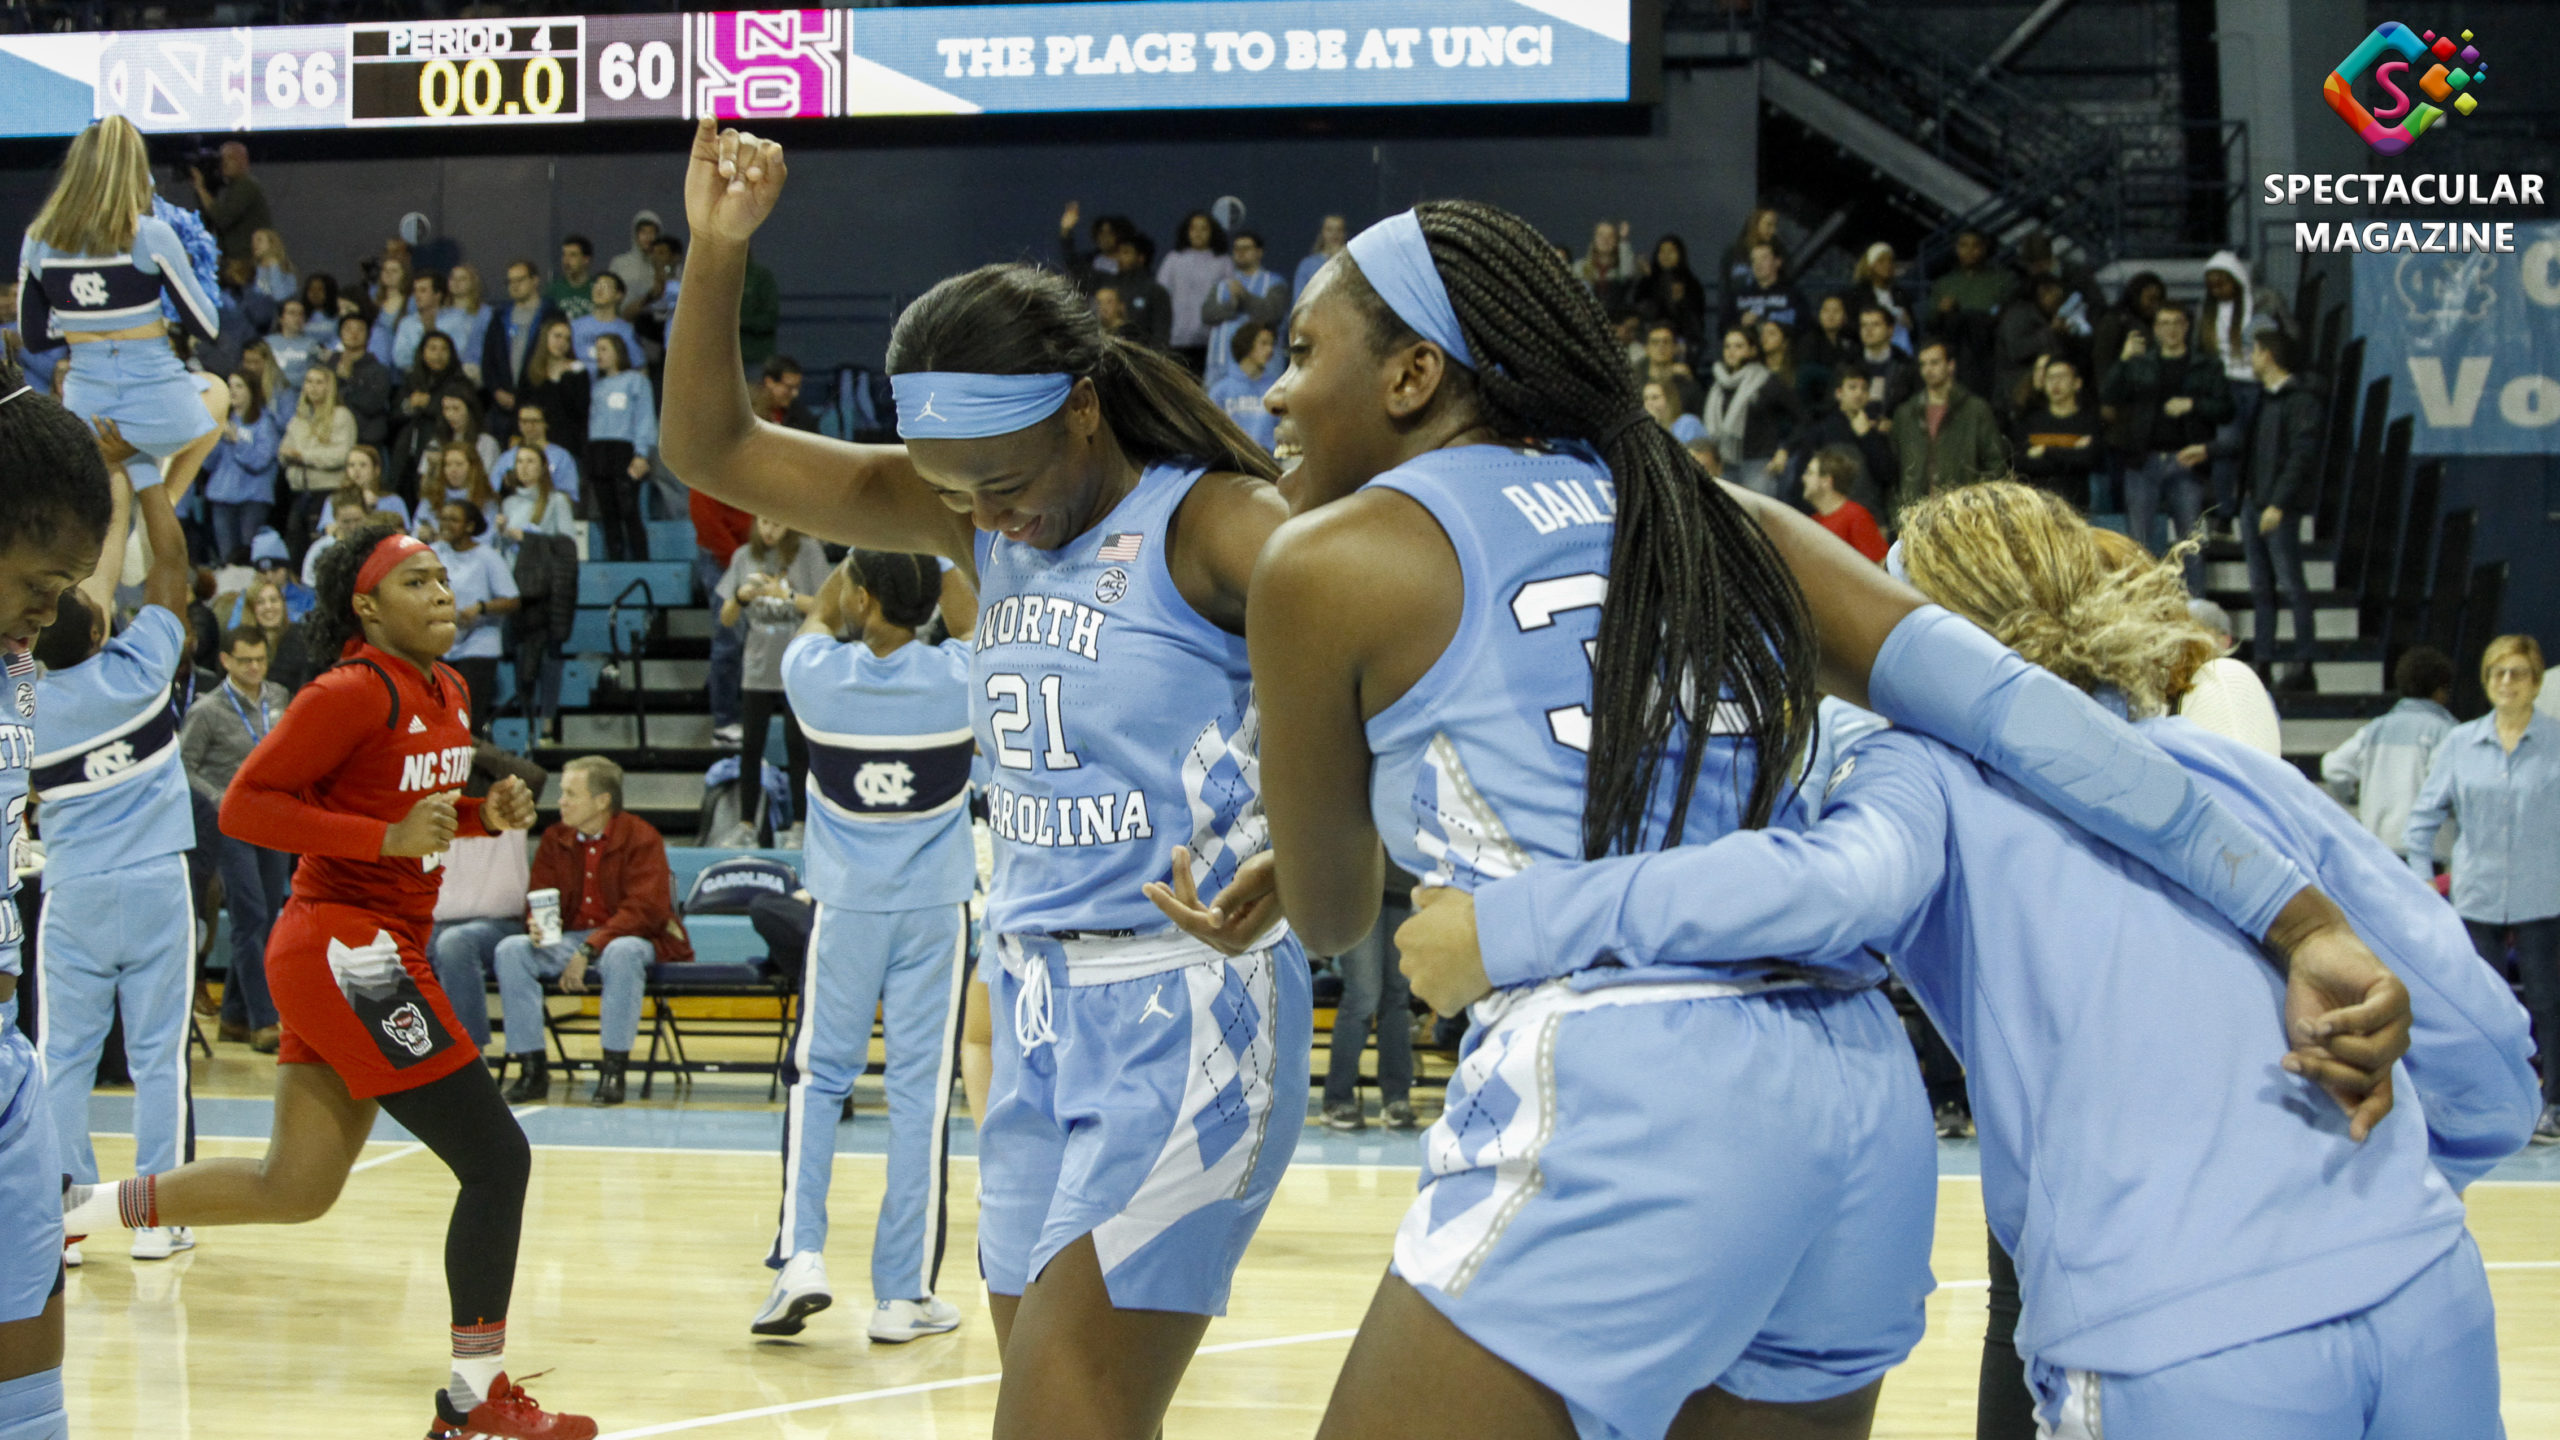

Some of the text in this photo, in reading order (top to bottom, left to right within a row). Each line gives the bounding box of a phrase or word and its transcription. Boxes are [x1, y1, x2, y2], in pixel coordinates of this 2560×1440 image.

[387, 25, 553, 57] PERIOD 4
[599, 41, 675, 100] 60
[937, 25, 1553, 78] THE PLACE TO BE AT UNC!
[265, 51, 337, 109] 66
[419, 57, 564, 117] 00.0
[976, 595, 1106, 662] NORTH
[986, 673, 1082, 772] 21
[398, 745, 474, 792] NC STA
[988, 780, 1153, 847] AROLINA
